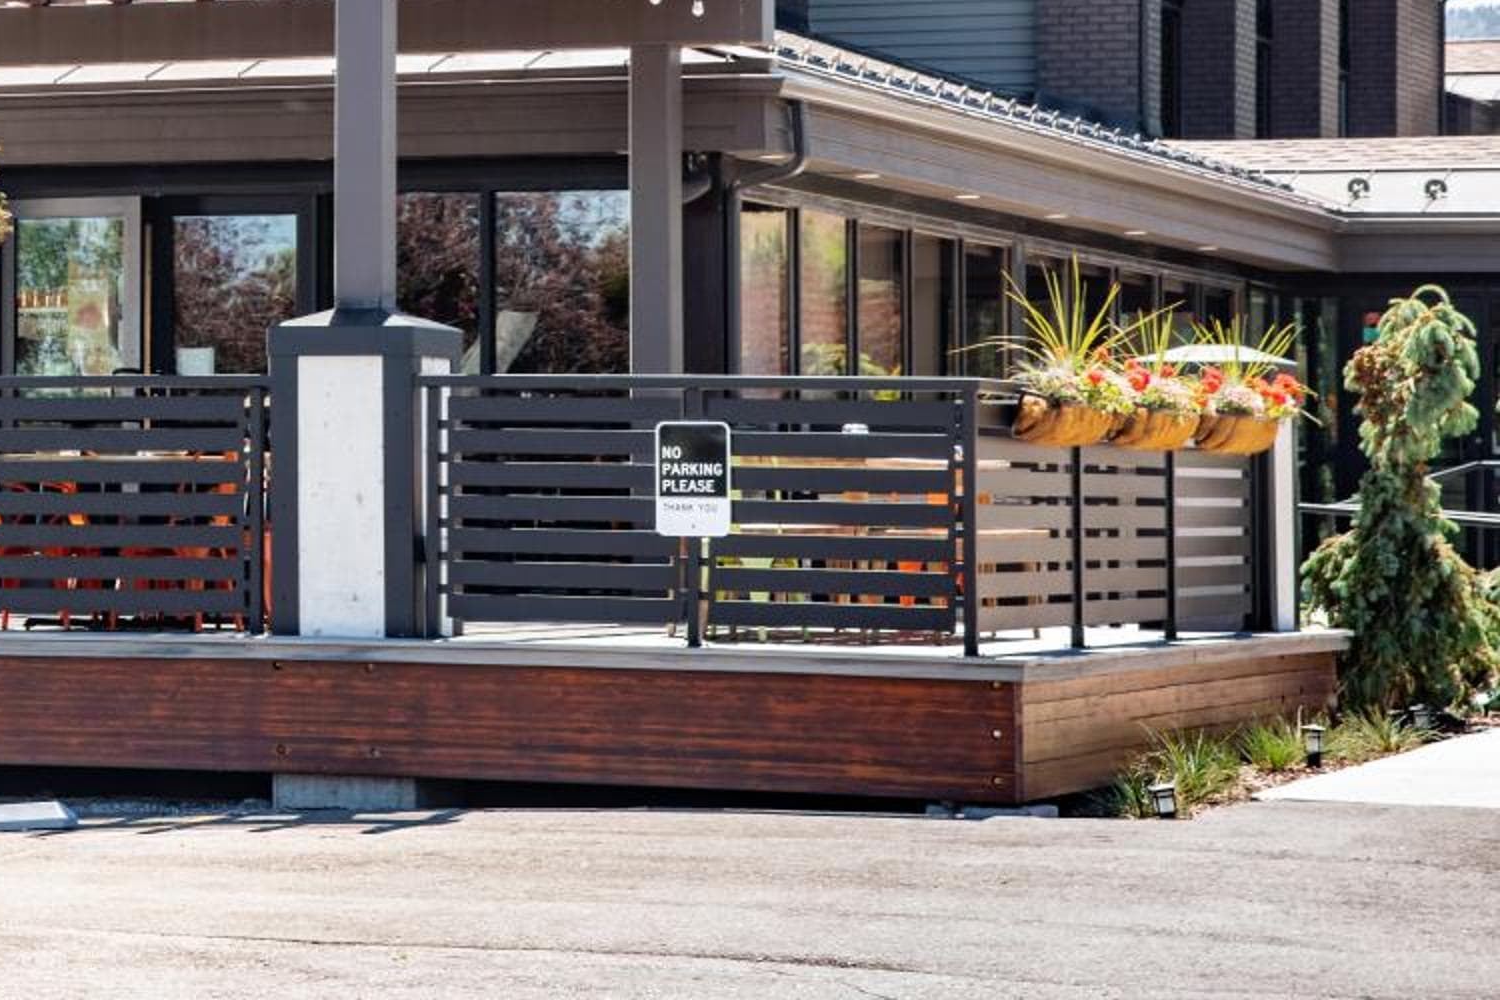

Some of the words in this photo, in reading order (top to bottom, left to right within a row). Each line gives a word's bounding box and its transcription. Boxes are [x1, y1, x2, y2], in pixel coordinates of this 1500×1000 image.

[661, 446, 682, 459] NO
[661, 463, 723, 476] PARKING
[661, 479, 716, 493] PLEASE
[662, 502, 694, 511] THANK
